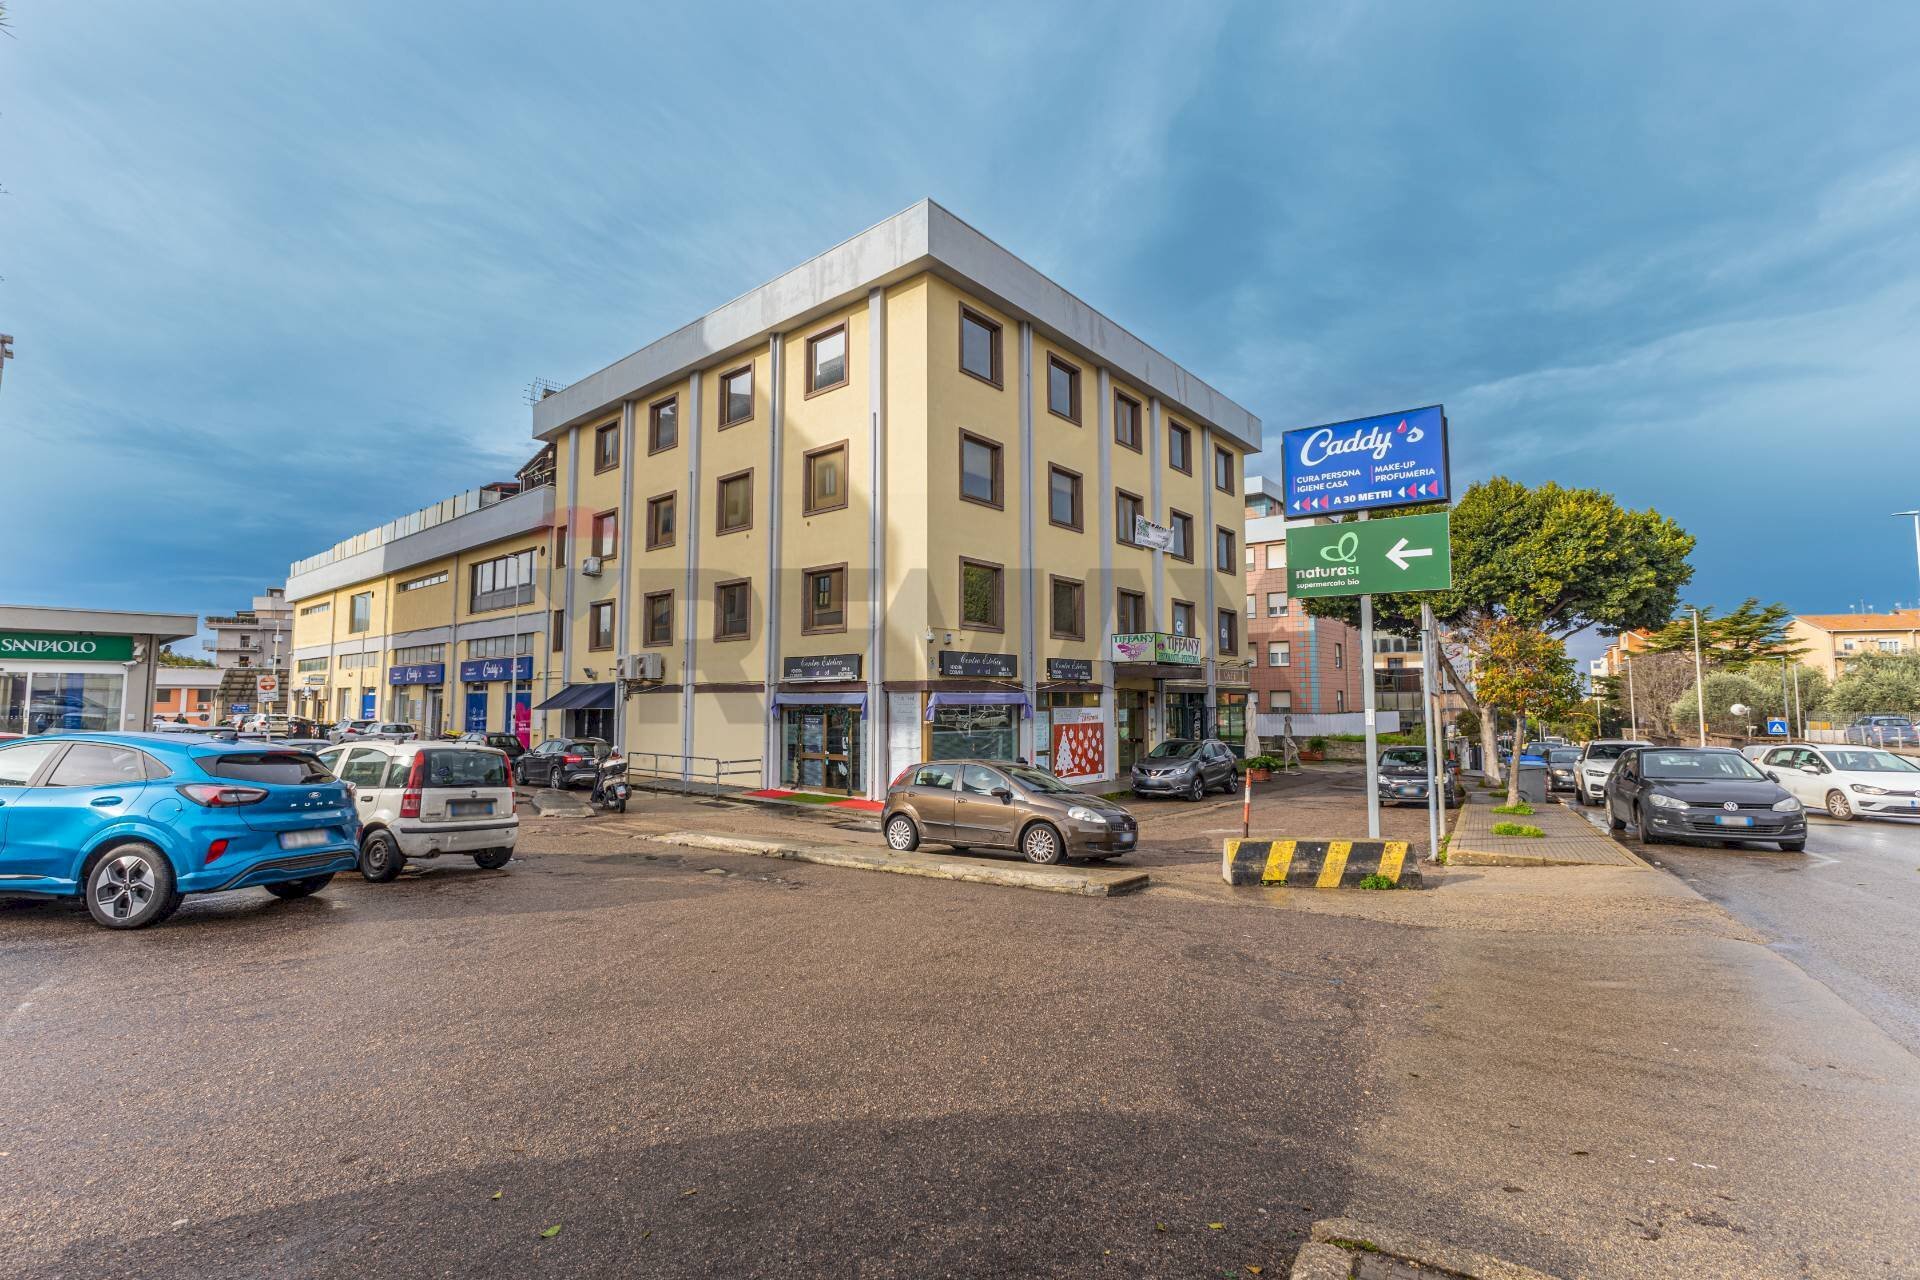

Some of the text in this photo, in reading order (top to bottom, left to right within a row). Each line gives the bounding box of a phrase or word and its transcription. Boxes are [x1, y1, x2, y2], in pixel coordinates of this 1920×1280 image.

[1300, 419, 1424, 467] Caddy's
[1374, 460, 1416, 473] MAKE-UP
[1296, 469, 1361, 484] CURA PERSONA
[1375, 468, 1435, 483] PROFUMERIA
[1297, 480, 1349, 493] IGIENE CASA
[1333, 490, 1393, 505] A 30 METRI
[1296, 580, 1346, 590] supermercato
[1, 638, 97, 654] SANPAOLO
[1113, 635, 1155, 644] TIFFANY
[1166, 636, 1200, 655] TIFFANY
